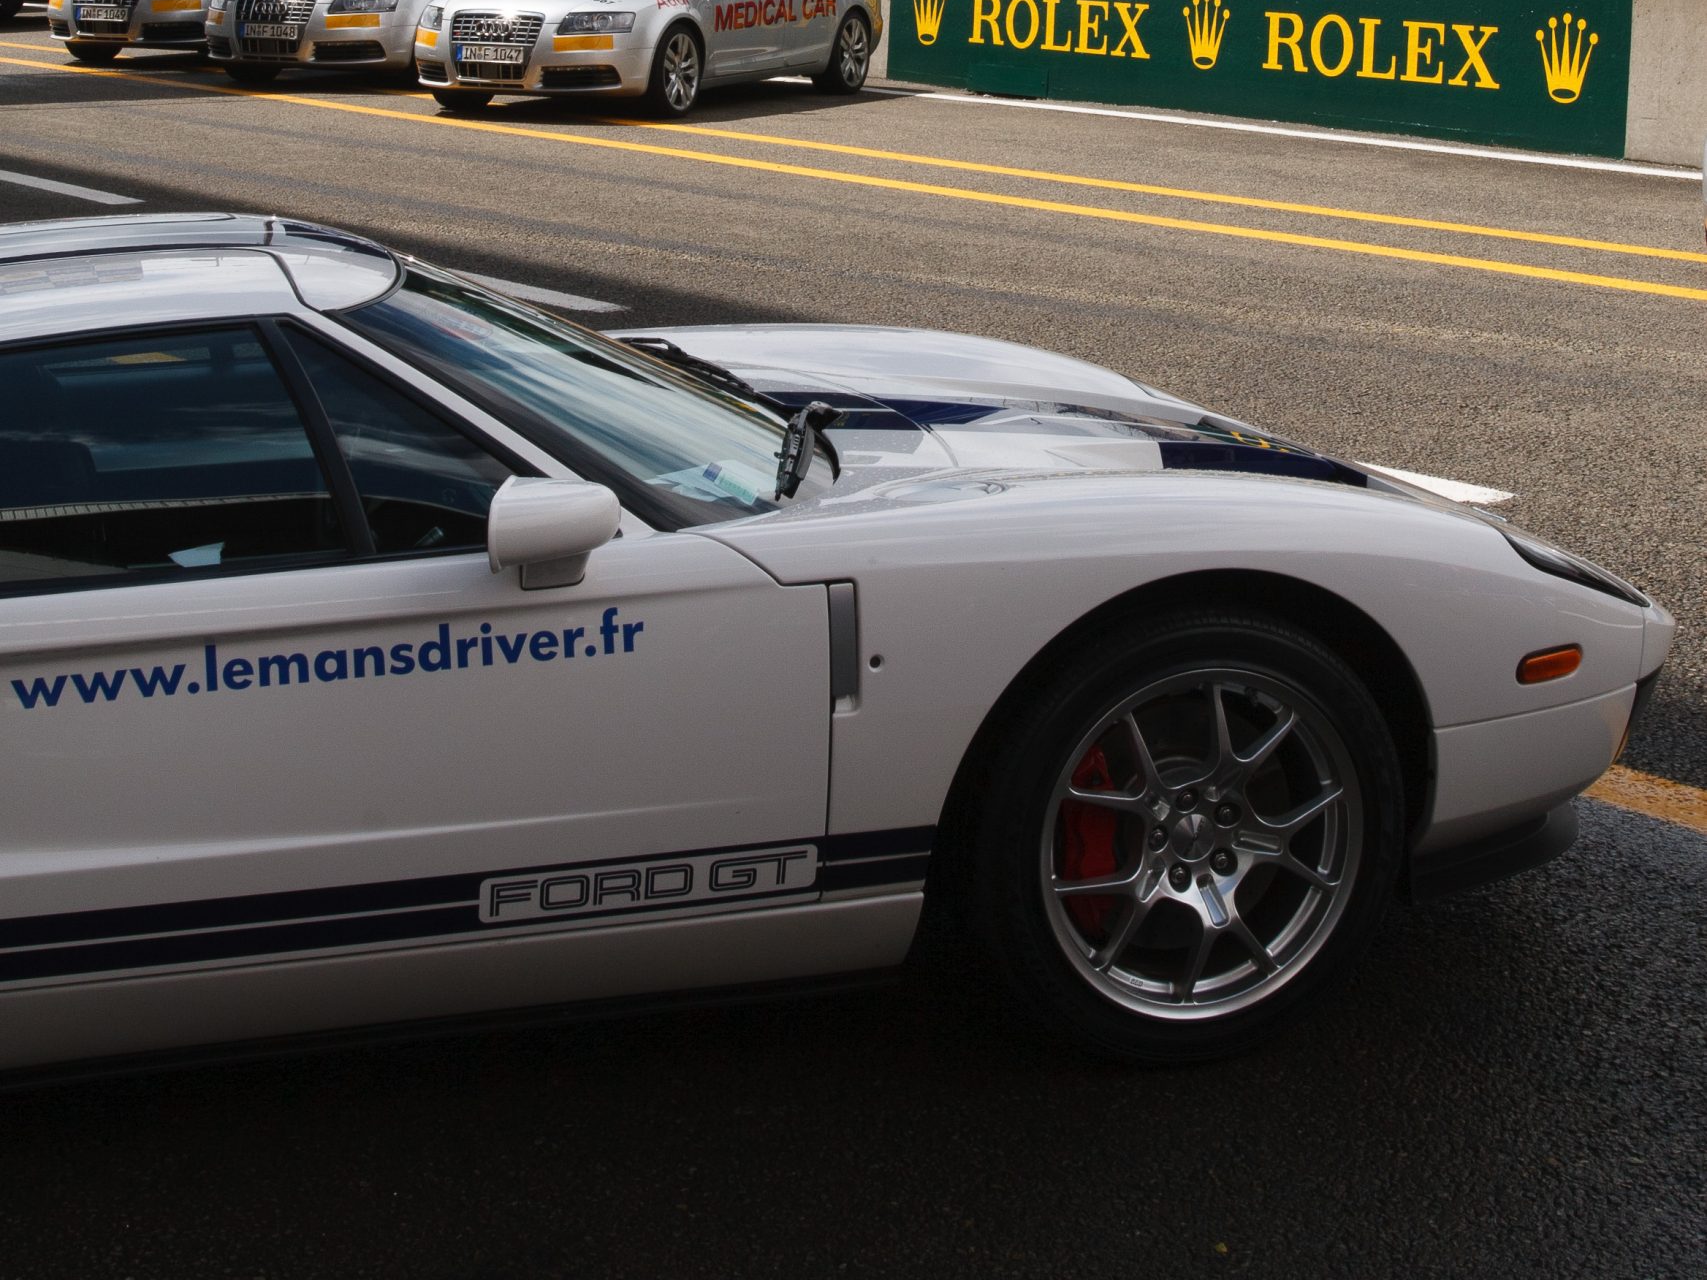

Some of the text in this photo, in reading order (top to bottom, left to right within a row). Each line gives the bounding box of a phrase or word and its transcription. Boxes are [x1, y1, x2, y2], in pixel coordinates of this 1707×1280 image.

[493, 48, 522, 61] 1047
[1262, 10, 1500, 90] ROLEX
[11, 607, 645, 710] www.lemansdriver.fr
[490, 850, 809, 918] FORD GT
